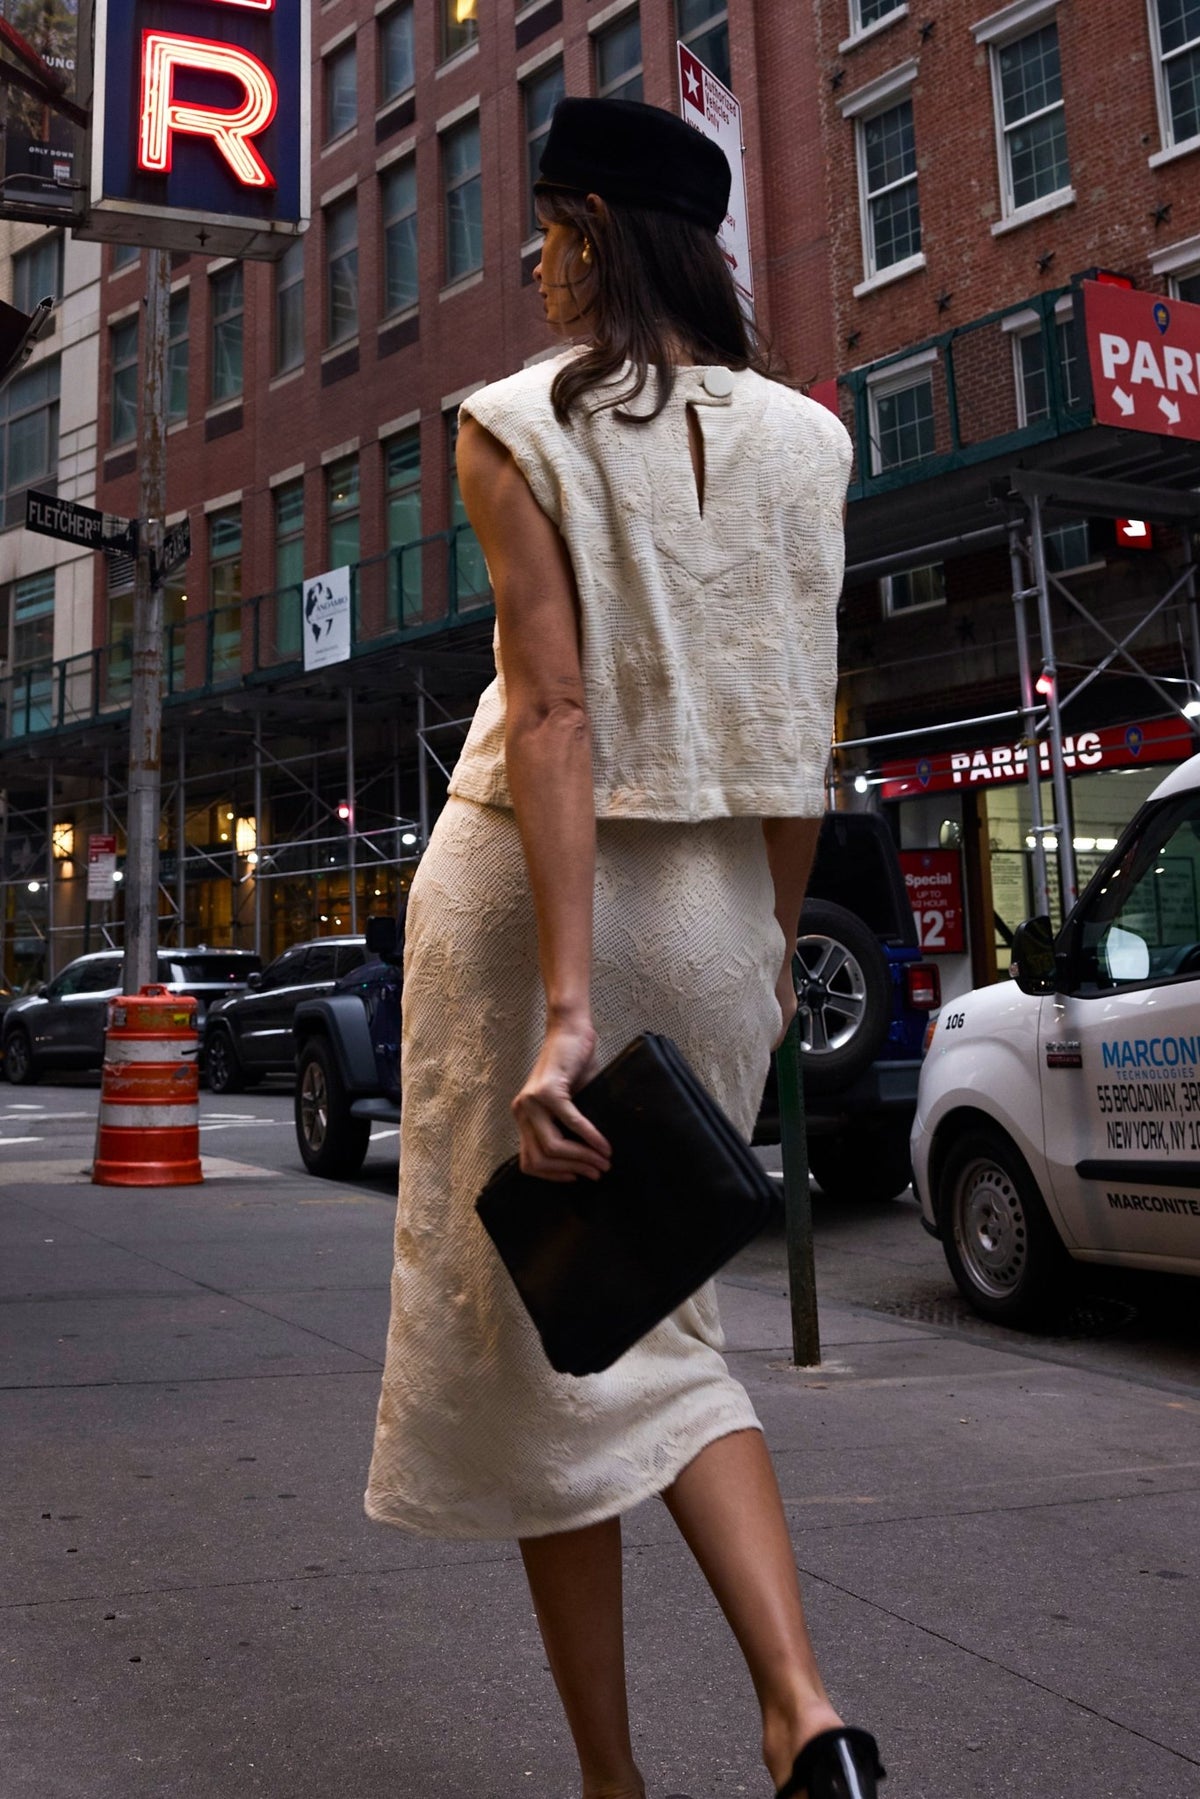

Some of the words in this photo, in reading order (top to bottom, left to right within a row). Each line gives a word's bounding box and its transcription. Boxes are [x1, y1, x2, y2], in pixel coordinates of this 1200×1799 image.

[41, 54, 75, 70] UNG
[138, 28, 278, 190] R
[704, 74, 736, 117] Authorized
[705, 89, 730, 125] Vehicles
[706, 107, 720, 132] Only
[1100, 332, 1200, 396] PAR
[29, 500, 93, 540] FLETCHER
[92, 520, 101, 532] ST
[905, 872, 952, 888] Special
[946, 1013, 965, 1030] 106
[1116, 1067, 1195, 1081] TECHNOLOGIES
[1096, 1084, 1113, 1113] 55
[1107, 1121, 1132, 1150] NEW
[1132, 1121, 1170, 1156] YORK,
[1170, 1121, 1186, 1150] NY
